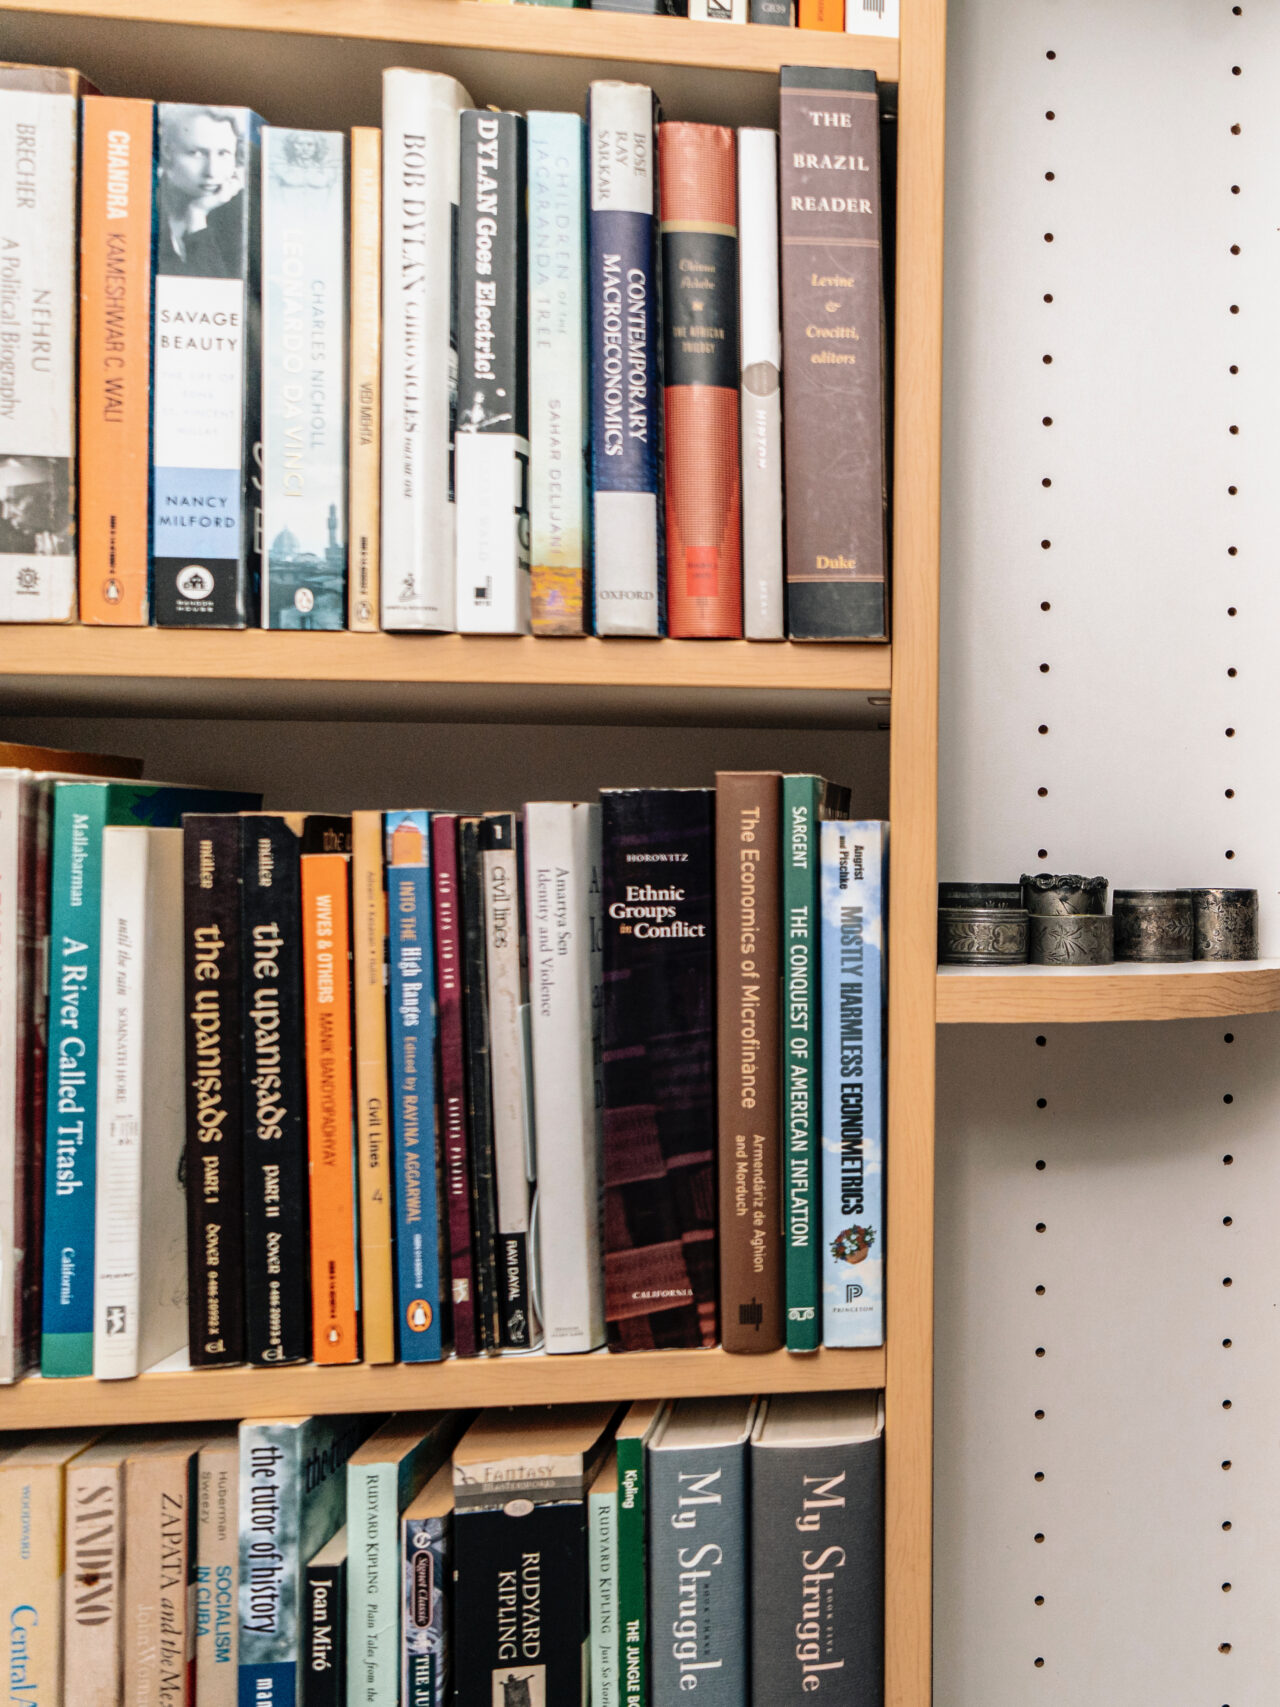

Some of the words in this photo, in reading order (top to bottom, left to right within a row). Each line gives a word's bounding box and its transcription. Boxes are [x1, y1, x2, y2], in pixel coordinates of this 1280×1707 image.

[808, 111, 853, 128] THE
[15, 122, 37, 209] BRECHER
[402, 133, 426, 188] BOB
[477, 118, 500, 214] DYLAN
[598, 130, 611, 200] SARKAR
[615, 131, 628, 168] RAY
[633, 132, 647, 178] BOSE
[792, 153, 870, 172] BRAZIL
[105, 129, 131, 220] CHANDRA
[531, 137, 552, 286] JACARANDA
[553, 156, 570, 280] CHILDREN
[790, 195, 873, 214] READER
[1, 236, 19, 251] A
[400, 198, 427, 294] DYLAN
[476, 218, 498, 275] Goes
[0, 255, 21, 327] Political
[104, 232, 127, 351] KAMESHWAR
[280, 229, 304, 375] LEONARDO
[810, 273, 855, 288] Levine
[30, 288, 53, 374] NEHRU
[160, 309, 240, 327] SAVAGE
[310, 279, 327, 361] CHARLES
[475, 279, 500, 381] Electric!
[103, 356, 124, 373] C.
[160, 334, 239, 352] BEAUTY
[601, 253, 624, 456] MACROECONOMICS
[625, 268, 648, 444] CONTEMPORARY
[810, 352, 856, 365] editors
[0, 331, 20, 420] Biography
[359, 382, 374, 406] VED
[103, 377, 124, 424] WALI
[282, 384, 304, 419] DA
[309, 369, 327, 450] NICHOLL
[359, 408, 374, 446] MEHTA
[548, 399, 563, 461] SAHAR
[281, 423, 305, 500] VINCI
[158, 515, 236, 529] MILFORD
[165, 495, 229, 509] NANCY
[815, 555, 857, 570] Duke
[600, 590, 655, 601] OXFORD
[493, 824, 503, 840] 1
[740, 806, 760, 842] The
[791, 806, 808, 869] SARGENT
[70, 813, 90, 907] Mallabarman
[198, 839, 217, 889] müller
[257, 838, 277, 888] müller
[626, 853, 689, 862] HOROWITZ
[838, 850, 850, 890] Pischke
[854, 845, 864, 881] Angrist
[398, 881, 417, 913] INTO
[491, 866, 511, 903] civil
[533, 868, 553, 922] Identity
[551, 867, 570, 926] Amartya
[626, 884, 686, 902] Ethnic
[740, 849, 760, 954] Economics
[315, 895, 333, 937] WIVES
[399, 918, 417, 941] THE
[492, 906, 512, 949] lines
[608, 902, 677, 923] Groups
[633, 920, 706, 939] Conflict
[790, 906, 808, 938] THE
[62, 936, 89, 957] A
[116, 949, 133, 966] the
[194, 924, 225, 980] the
[252, 922, 284, 979] the
[316, 939, 333, 951] &
[399, 946, 422, 977] High
[538, 925, 553, 953] and
[556, 931, 571, 956] Sen
[839, 906, 864, 978] MOSTLY
[317, 953, 335, 1004] OTHERS
[538, 957, 554, 1017] Violence
[740, 961, 760, 979] of
[789, 944, 809, 1031] CONQUEST
[60, 963, 89, 1032] River
[400, 983, 422, 1027] Ranges
[116, 1006, 130, 1067] SOMNATH
[319, 1012, 336, 1053] MANIK
[740, 985, 760, 1109] Microfinance
[790, 1036, 809, 1059] OF
[839, 981, 864, 1078] HARMLESS
[58, 1037, 87, 1114] Called
[404, 1036, 418, 1073] Edited
[401, 1077, 418, 1091] by
[320, 1056, 338, 1167] BANDYOPADHYAY
[366, 1097, 382, 1127] Civil
[403, 1095, 420, 1147] RAVINA
[790, 1064, 809, 1152] AMERICAN
[55, 1120, 85, 1197] Titash
[367, 1132, 383, 1168] Lines
[735, 1134, 747, 1151] and
[840, 1083, 865, 1216] ECONOMETRICS
[404, 1152, 421, 1224] AGGARWAL
[735, 1153, 748, 1217] Morduch
[790, 1158, 809, 1247] INFLATION
[752, 1208, 767, 1226] de
[505, 1240, 521, 1265] RAVI
[752, 1230, 767, 1273] Aghion
[60, 1246, 76, 1305] California
[506, 1267, 521, 1301] DAYAL
[631, 1288, 694, 1300] CALIFORNIA
[250, 1446, 284, 1478] the
[200, 1471, 213, 1525] Sweezy
[216, 1471, 229, 1541] Huberman
[250, 1484, 280, 1536] tutor
[365, 1474, 380, 1540] RUDYARD
[622, 1469, 638, 1509] Kipling
[670, 1466, 722, 1529] My
[795, 1469, 847, 1532] My
[20, 1485, 32, 1560] WOODWARD
[159, 1491, 183, 1590] ZAPATA
[598, 1505, 612, 1573] RUDYARD
[196, 1566, 211, 1583] IN
[247, 1543, 284, 1562] of
[365, 1543, 380, 1594] KIPLING
[415, 1557, 430, 1588] Signet
[160, 1598, 183, 1636] and
[196, 1587, 211, 1638] CUBA
[214, 1565, 232, 1663] SOCIALISM
[242, 1566, 282, 1634] history
[308, 1579, 333, 1622] Joan
[367, 1603, 380, 1629] Plain
[497, 1570, 518, 1660] KIPLING
[521, 1551, 541, 1659] RUDYARD
[599, 1577, 612, 1634] KIPLING
[672, 1543, 723, 1692] Struggle
[795, 1545, 847, 1693] Struggle
[9, 1603, 39, 1692] Central
[160, 1640, 183, 1667] the
[311, 1625, 333, 1671] Miró
[366, 1633, 378, 1658] Tales
[599, 1644, 612, 1664] Just
[626, 1619, 640, 1643] THE
[363, 1659, 378, 1683] from
[414, 1654, 431, 1686] THE
[601, 1667, 612, 1680] So
[626, 1645, 640, 1692] JUNGLE
[366, 1687, 378, 1702] the
